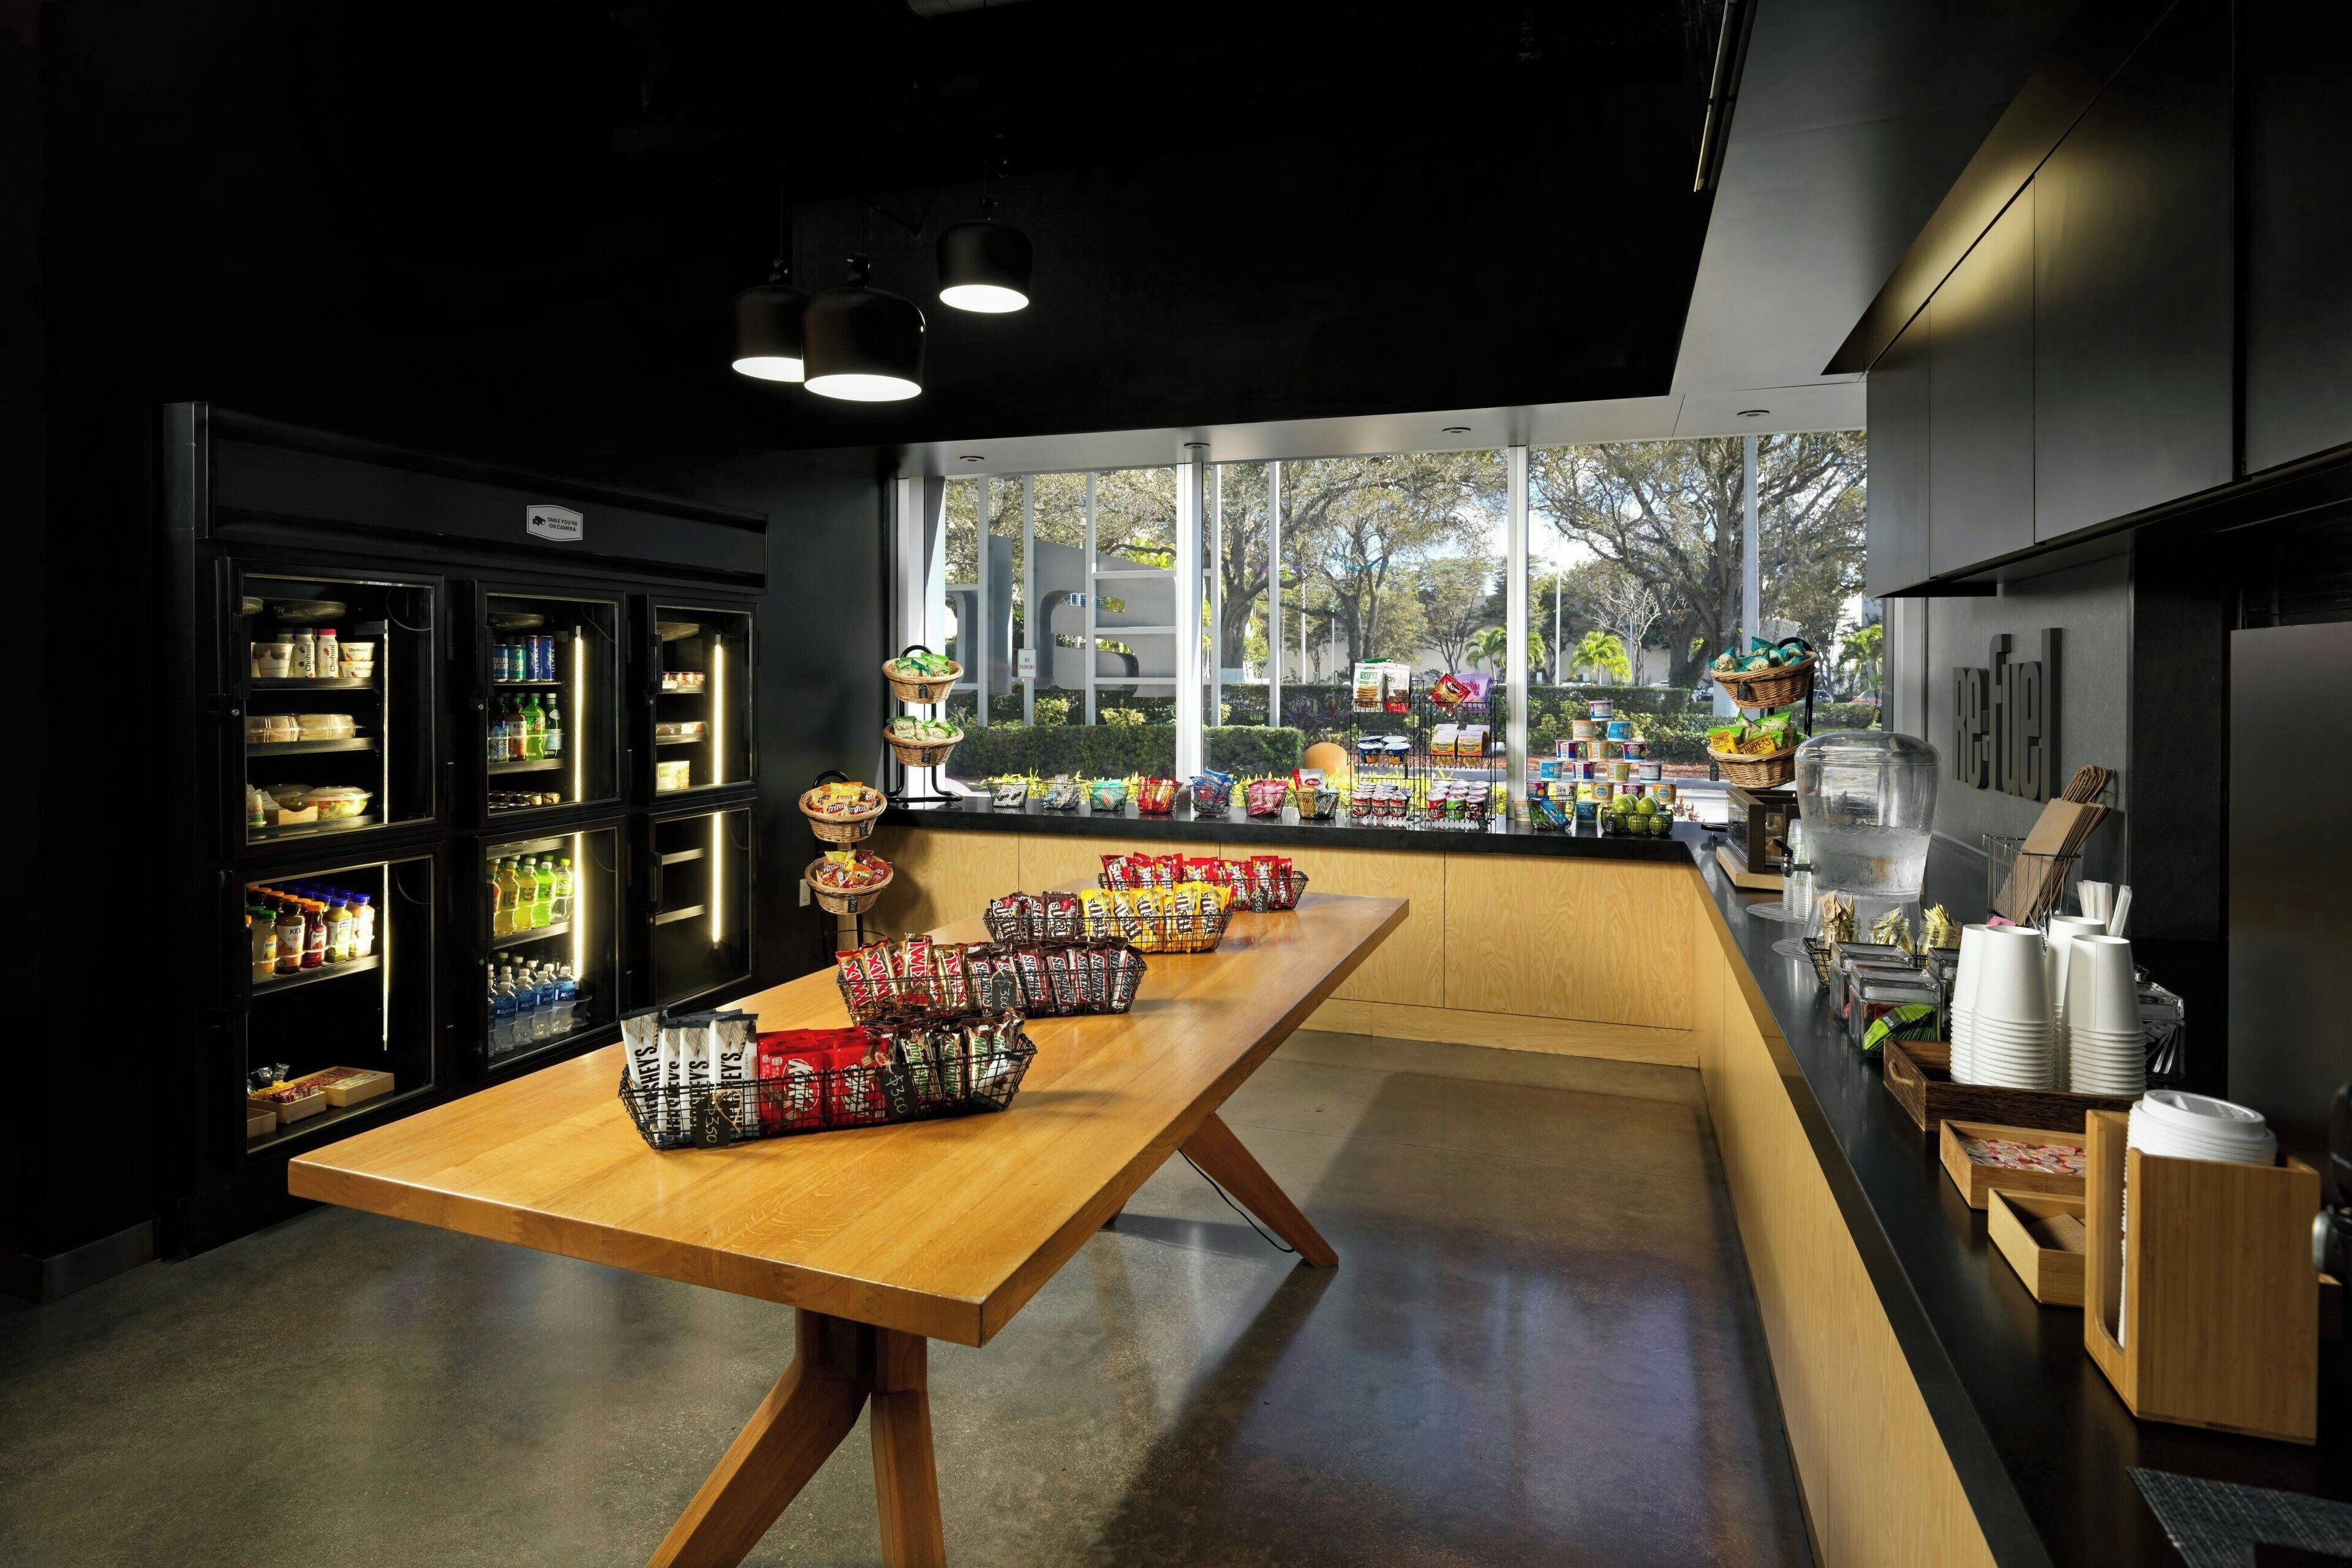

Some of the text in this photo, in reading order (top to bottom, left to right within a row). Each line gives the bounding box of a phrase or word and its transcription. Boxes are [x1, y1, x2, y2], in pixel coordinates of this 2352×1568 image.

[1743, 739, 1771, 755] HIPPEAS
[827, 804, 846, 813] Fritos
[908, 938, 929, 988] TWIX
[1023, 956, 1042, 1000] SNICKERS
[1053, 958, 1072, 1001] SNICKERS
[1093, 956, 1103, 1001] SNICKERS
[993, 976, 1012, 1008] $3.00
[635, 1046, 660, 1120] HERSHEY'S
[886, 1074, 908, 1114] $3.00
[704, 1101, 723, 1143] $3.50
